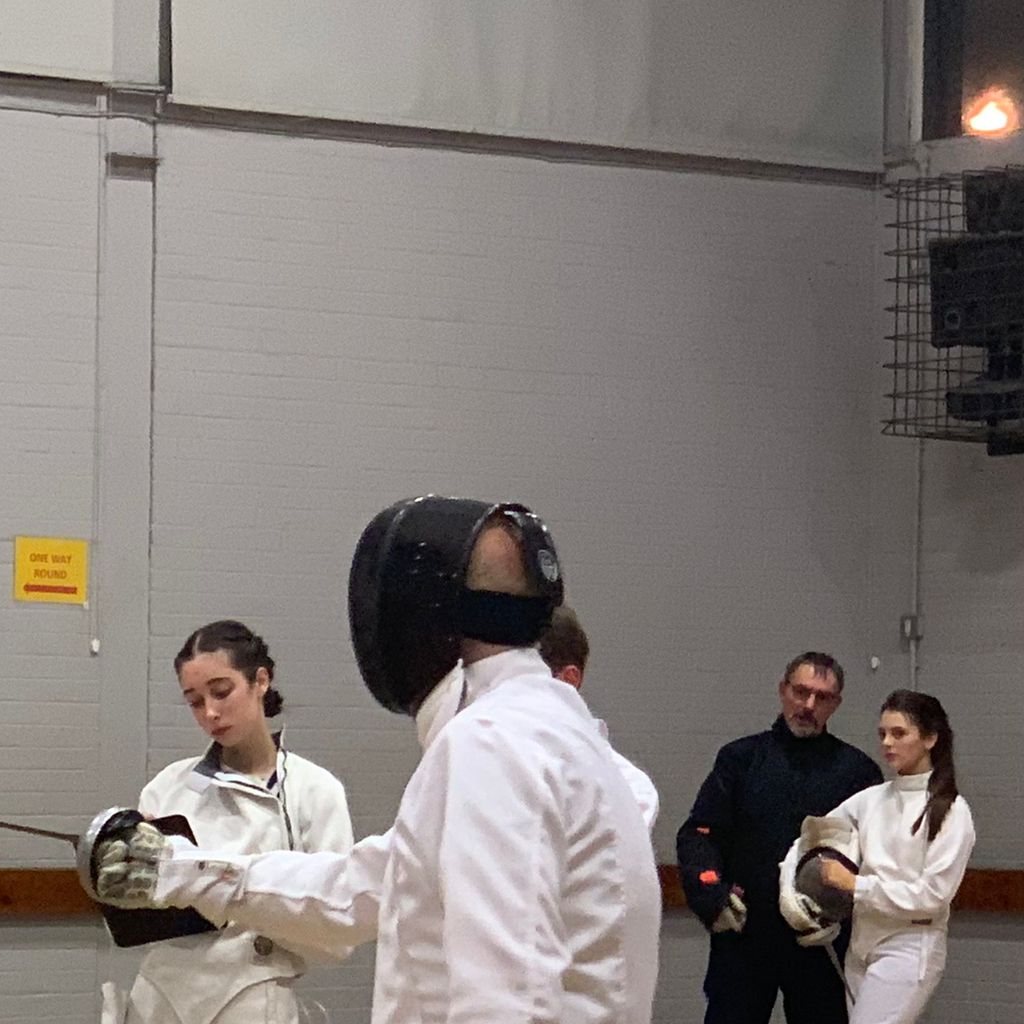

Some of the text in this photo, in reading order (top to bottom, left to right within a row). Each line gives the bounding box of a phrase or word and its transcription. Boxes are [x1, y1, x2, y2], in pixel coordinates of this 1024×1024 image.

[29, 553, 72, 564] ONE WAY
[33, 569, 68, 579] ROUND
